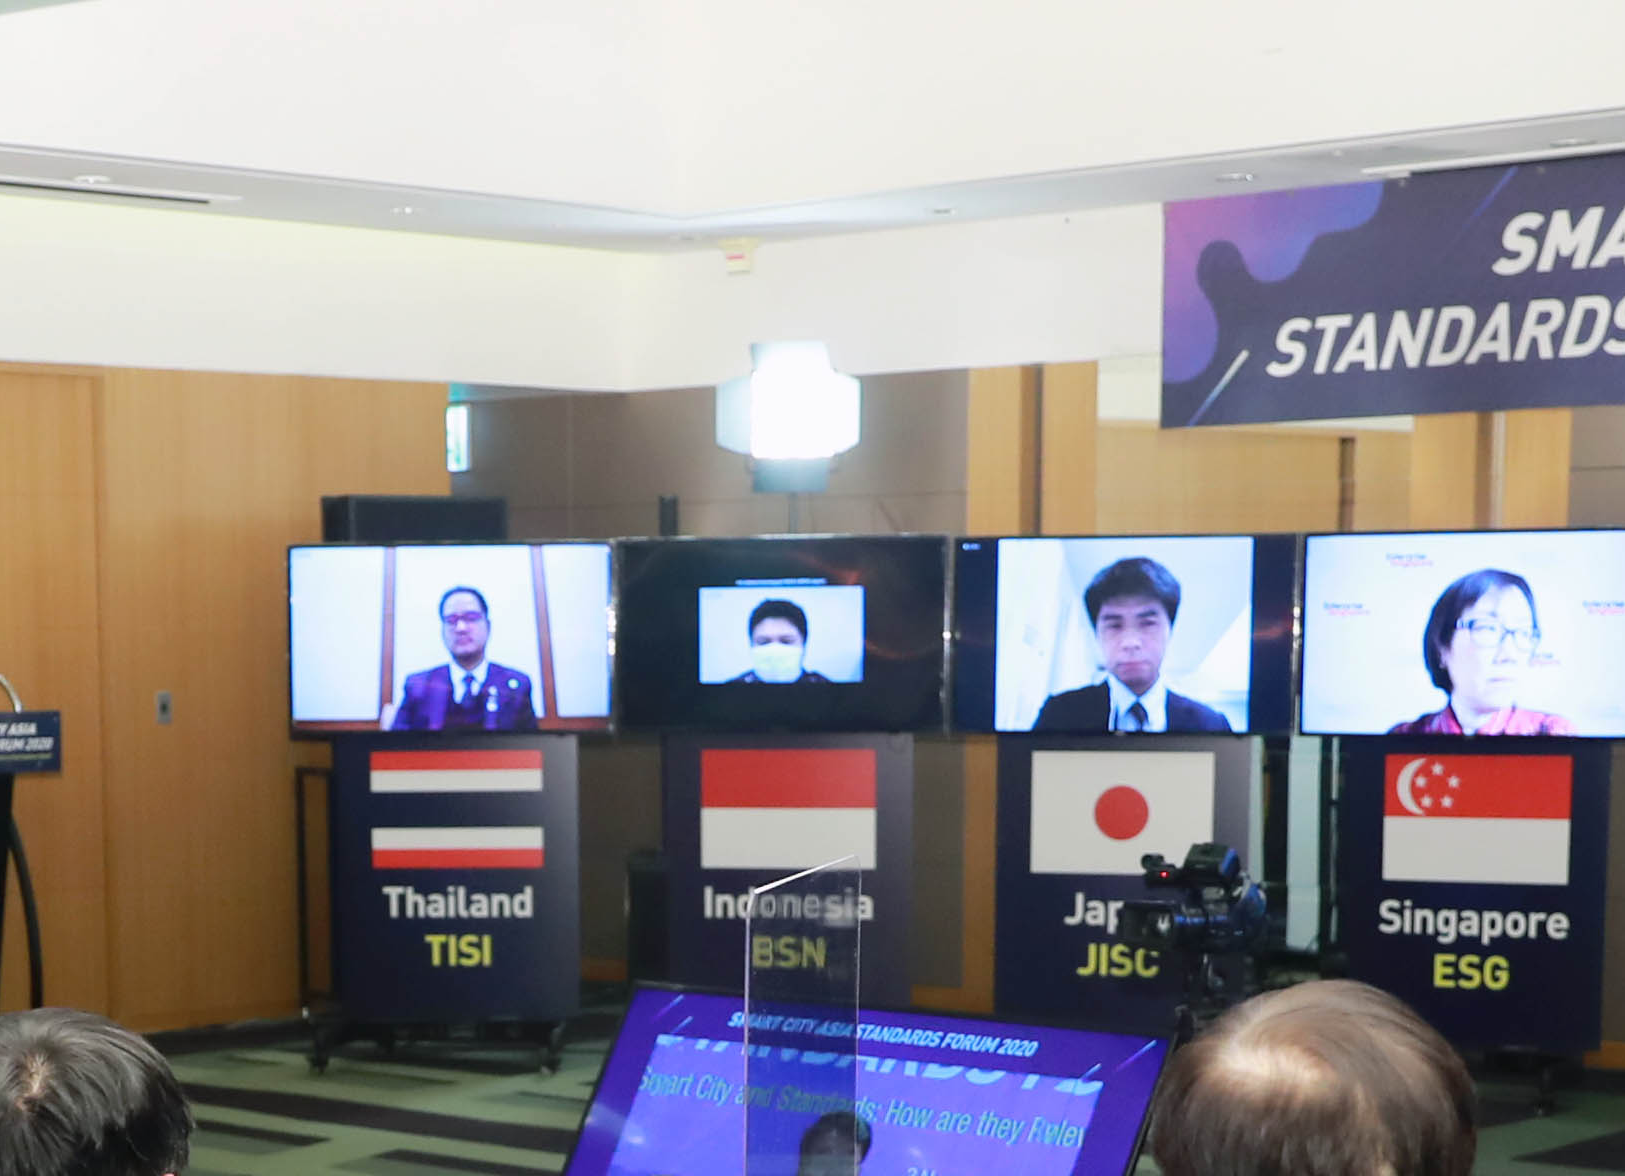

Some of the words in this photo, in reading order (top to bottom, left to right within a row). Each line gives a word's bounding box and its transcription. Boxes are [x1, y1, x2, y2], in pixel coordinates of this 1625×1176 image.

[7, 721, 37, 736] ASIA
[383, 885, 533, 920] Thailand
[703, 886, 874, 921] Indonesia
[1379, 900, 1570, 943] Singapore
[425, 935, 492, 966] TISI
[752, 935, 827, 968] BSN
[1076, 942, 1160, 977] JISC
[1432, 954, 1510, 990] ESG
[728, 1011, 781, 1031] SMART
[782, 1017, 815, 1033] CITY
[815, 1020, 856, 1038] ASIA
[855, 1023, 943, 1048] STANDARDS
[941, 1032, 999, 1053] FORUM
[997, 1040, 1039, 1058] 2020
[696, 1073, 732, 1107] City
[885, 1099, 931, 1127] How
[936, 1110, 971, 1134] are
[976, 1112, 1024, 1145] they
